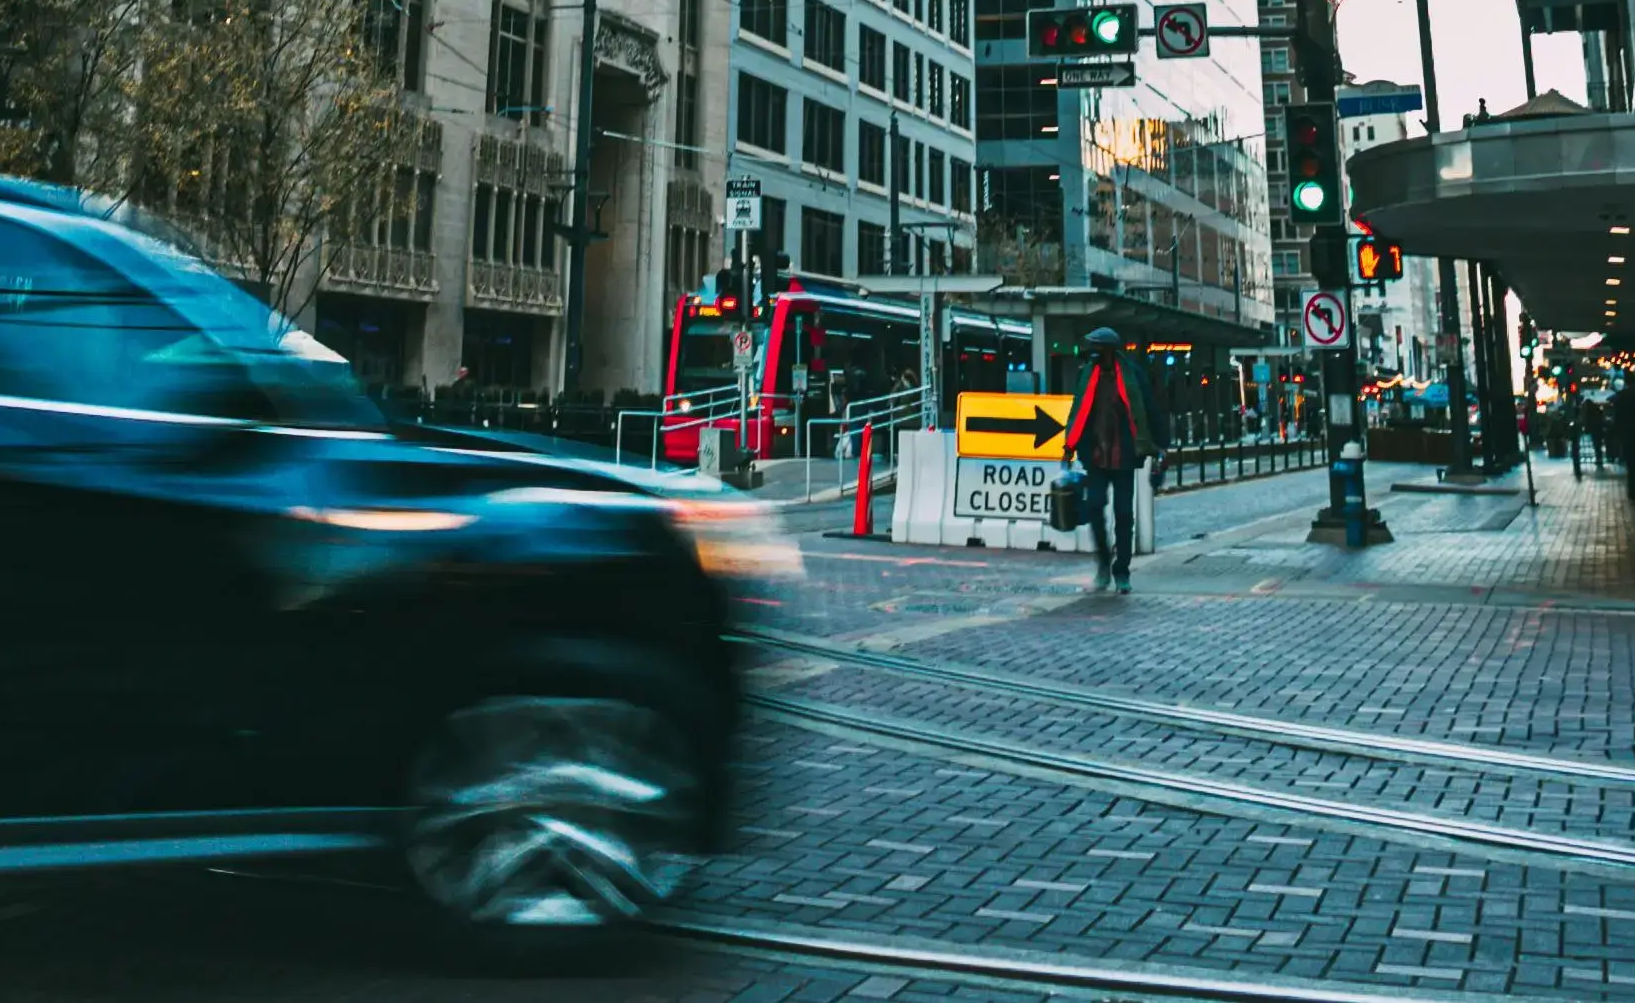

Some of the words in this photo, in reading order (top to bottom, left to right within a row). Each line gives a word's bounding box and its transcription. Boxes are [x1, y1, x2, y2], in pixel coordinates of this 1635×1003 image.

[1062, 70, 1082, 83] ONE
[1090, 69, 1111, 82] WAY
[729, 190, 756, 198] SIGNAL
[983, 464, 1046, 486] ROAD
